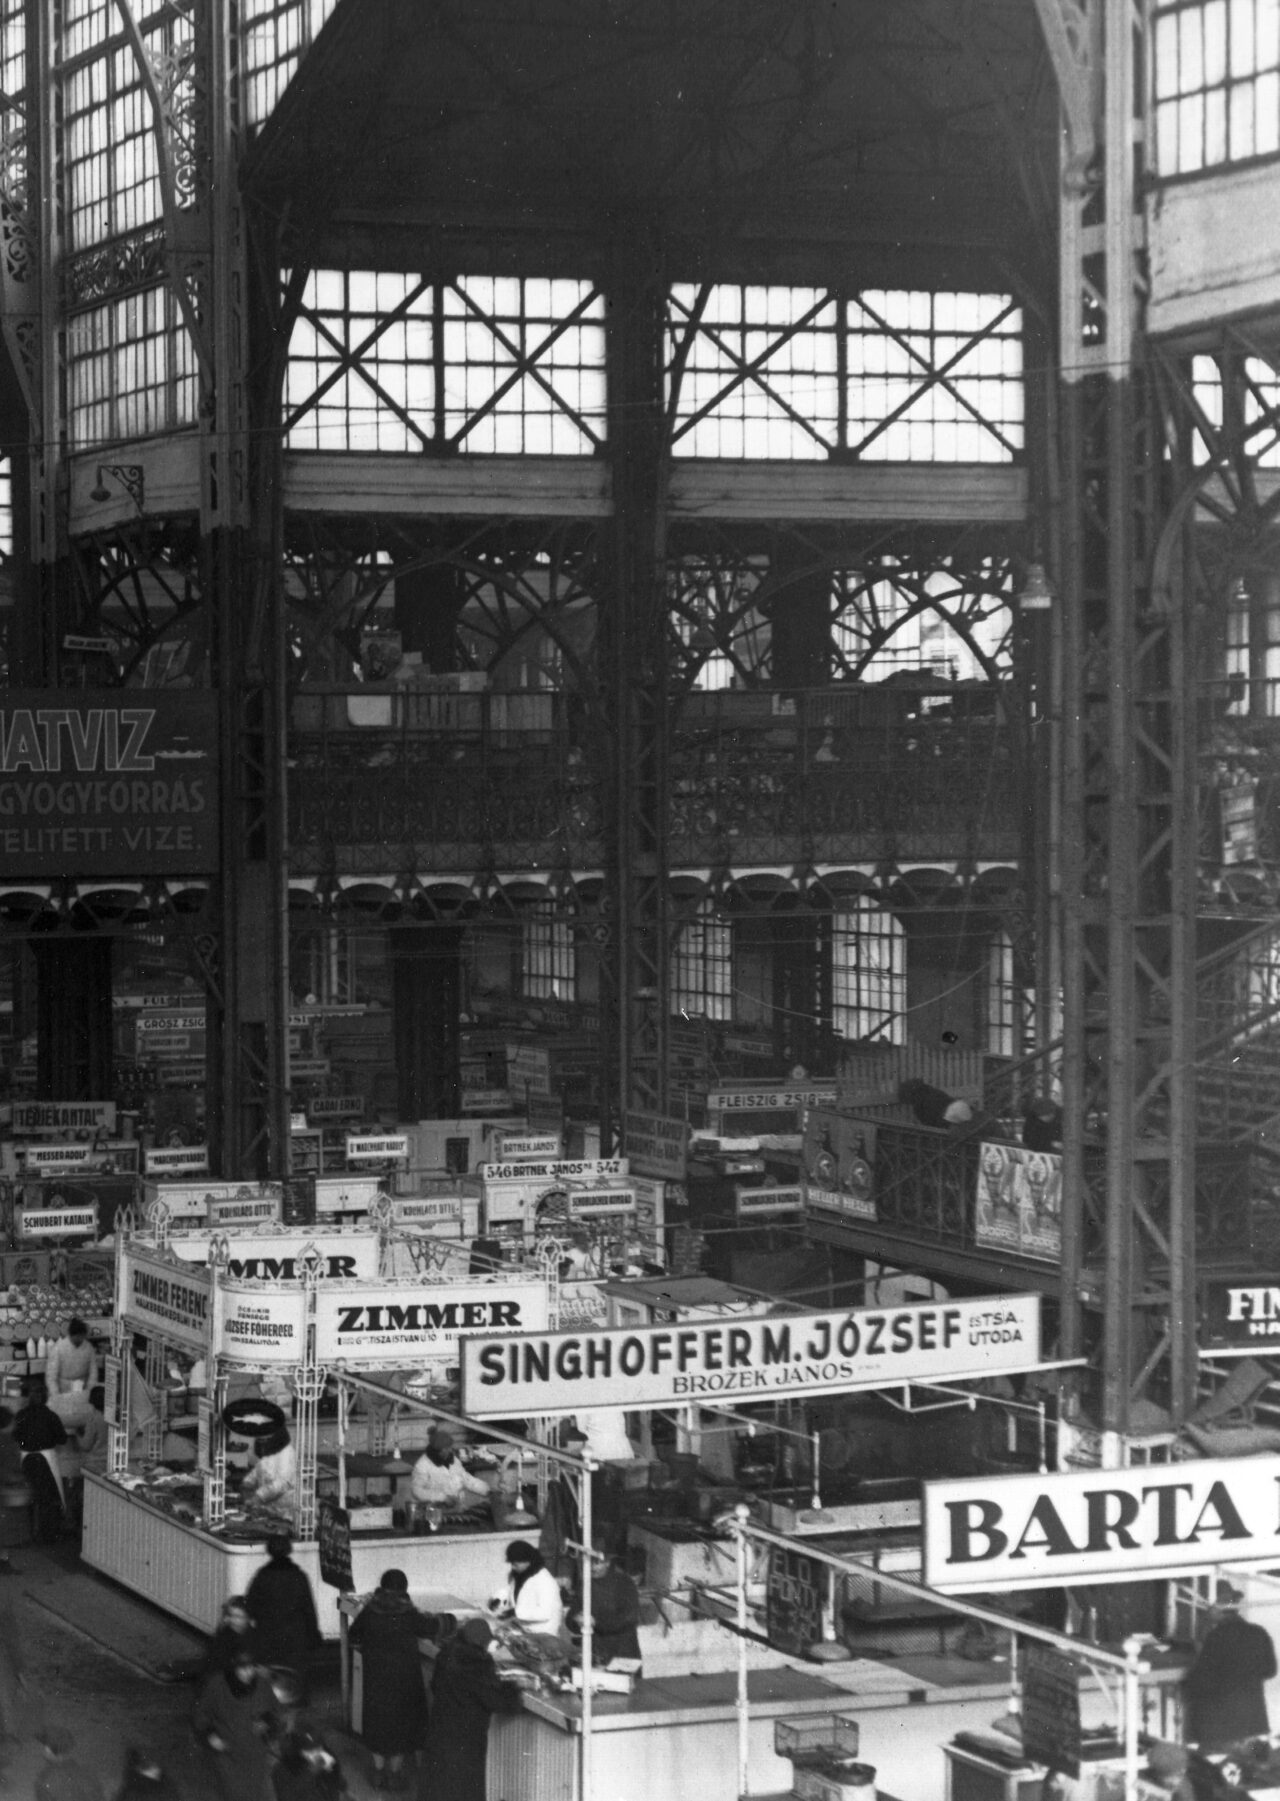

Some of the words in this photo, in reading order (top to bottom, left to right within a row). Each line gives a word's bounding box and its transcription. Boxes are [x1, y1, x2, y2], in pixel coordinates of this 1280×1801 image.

[718, 1094, 777, 1108] FLEISZIG
[487, 1165, 511, 1179] 546
[513, 1164, 548, 1177] BRTNEK
[596, 1161, 620, 1174] 547
[24, 1215, 62, 1228] SCHUBERT
[63, 1214, 93, 1226] KATALIN
[190, 1255, 358, 1280] MMR
[134, 1269, 169, 1305] ZIMMER
[171, 1282, 207, 1319] FERENC
[337, 1300, 523, 1333] ZIMMER
[479, 1325, 754, 1386] SINGHOFFER
[761, 1324, 802, 1365] M.
[806, 1309, 963, 1366] JÓZSEF
[944, 1480, 1254, 1564] BARTA
